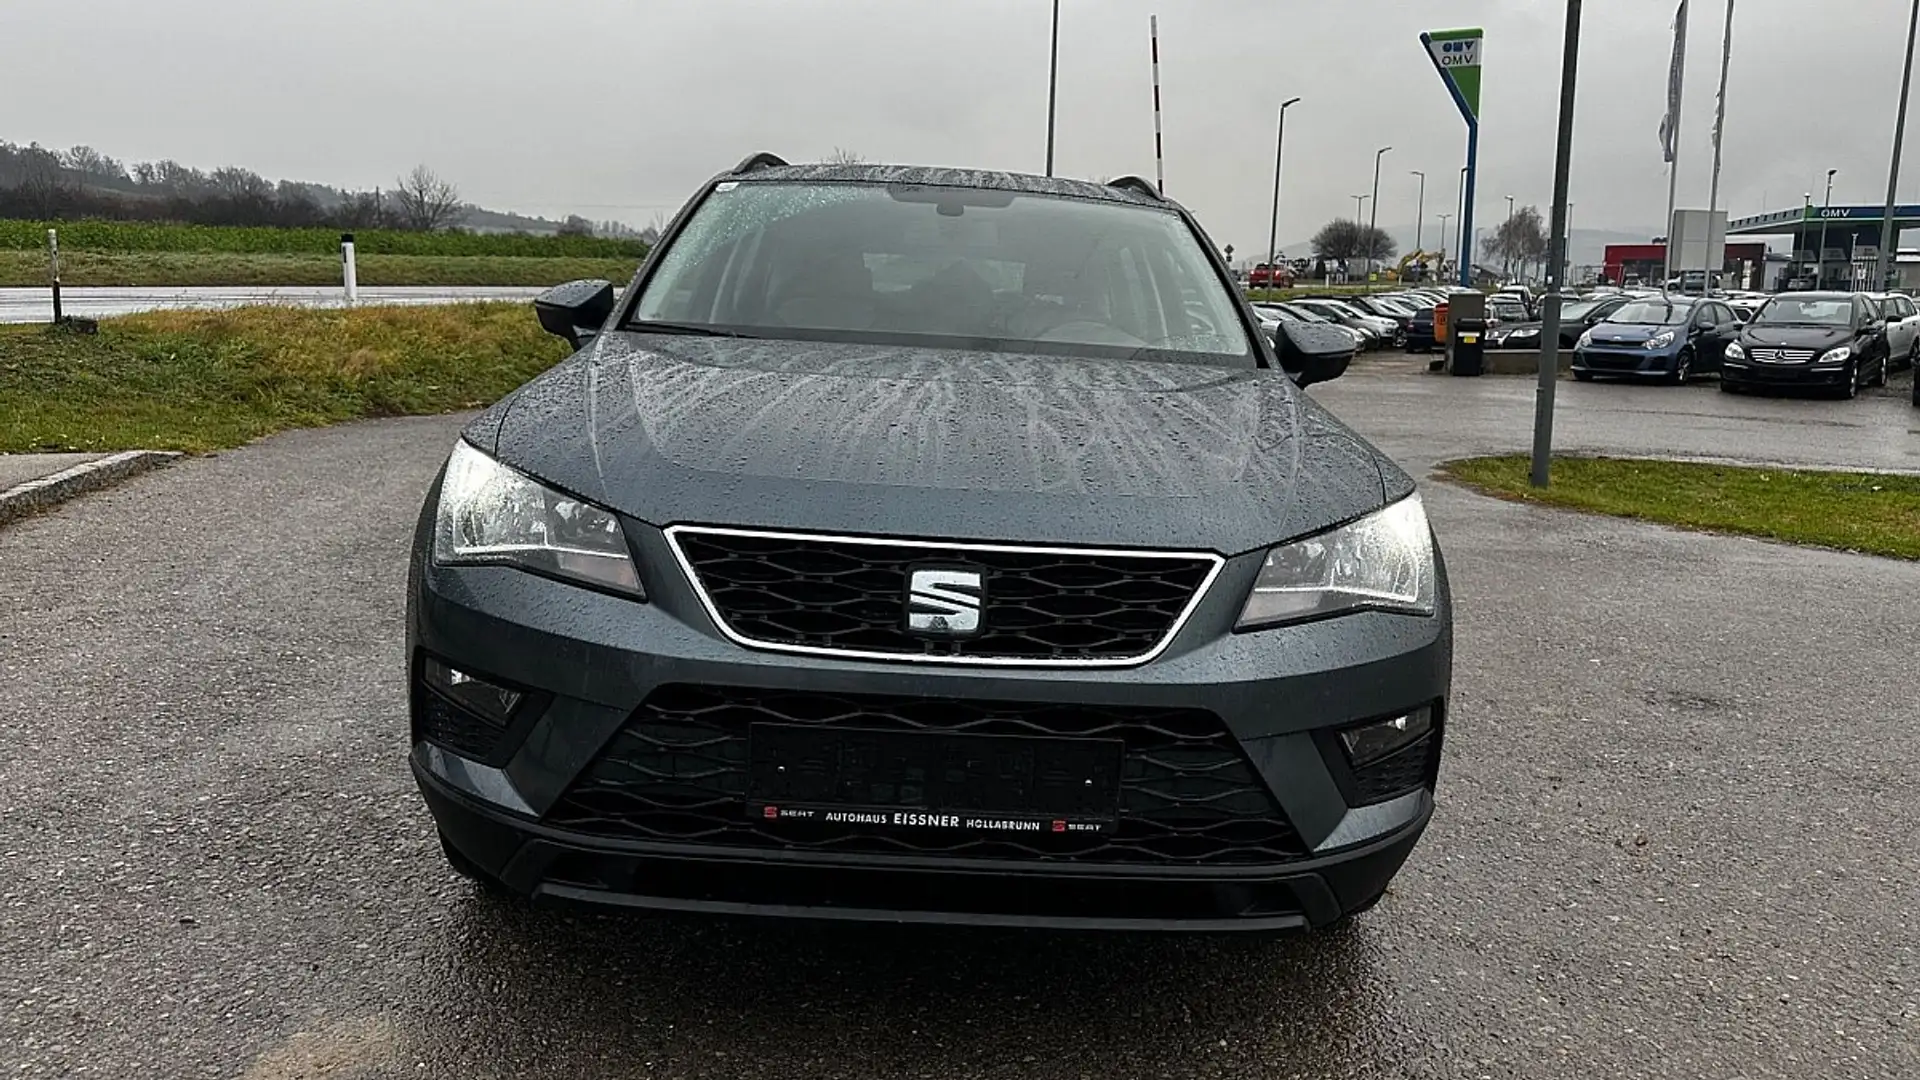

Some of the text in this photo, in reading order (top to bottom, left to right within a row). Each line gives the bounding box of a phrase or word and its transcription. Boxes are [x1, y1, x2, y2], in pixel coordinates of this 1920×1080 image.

[1441, 54, 1473, 65] OMV
[1821, 208, 1850, 217] OMV
[825, 812, 887, 824] AUTOHAUS
[894, 813, 960, 827] EISSNER
[966, 819, 1040, 831] HOLLABRUNN
